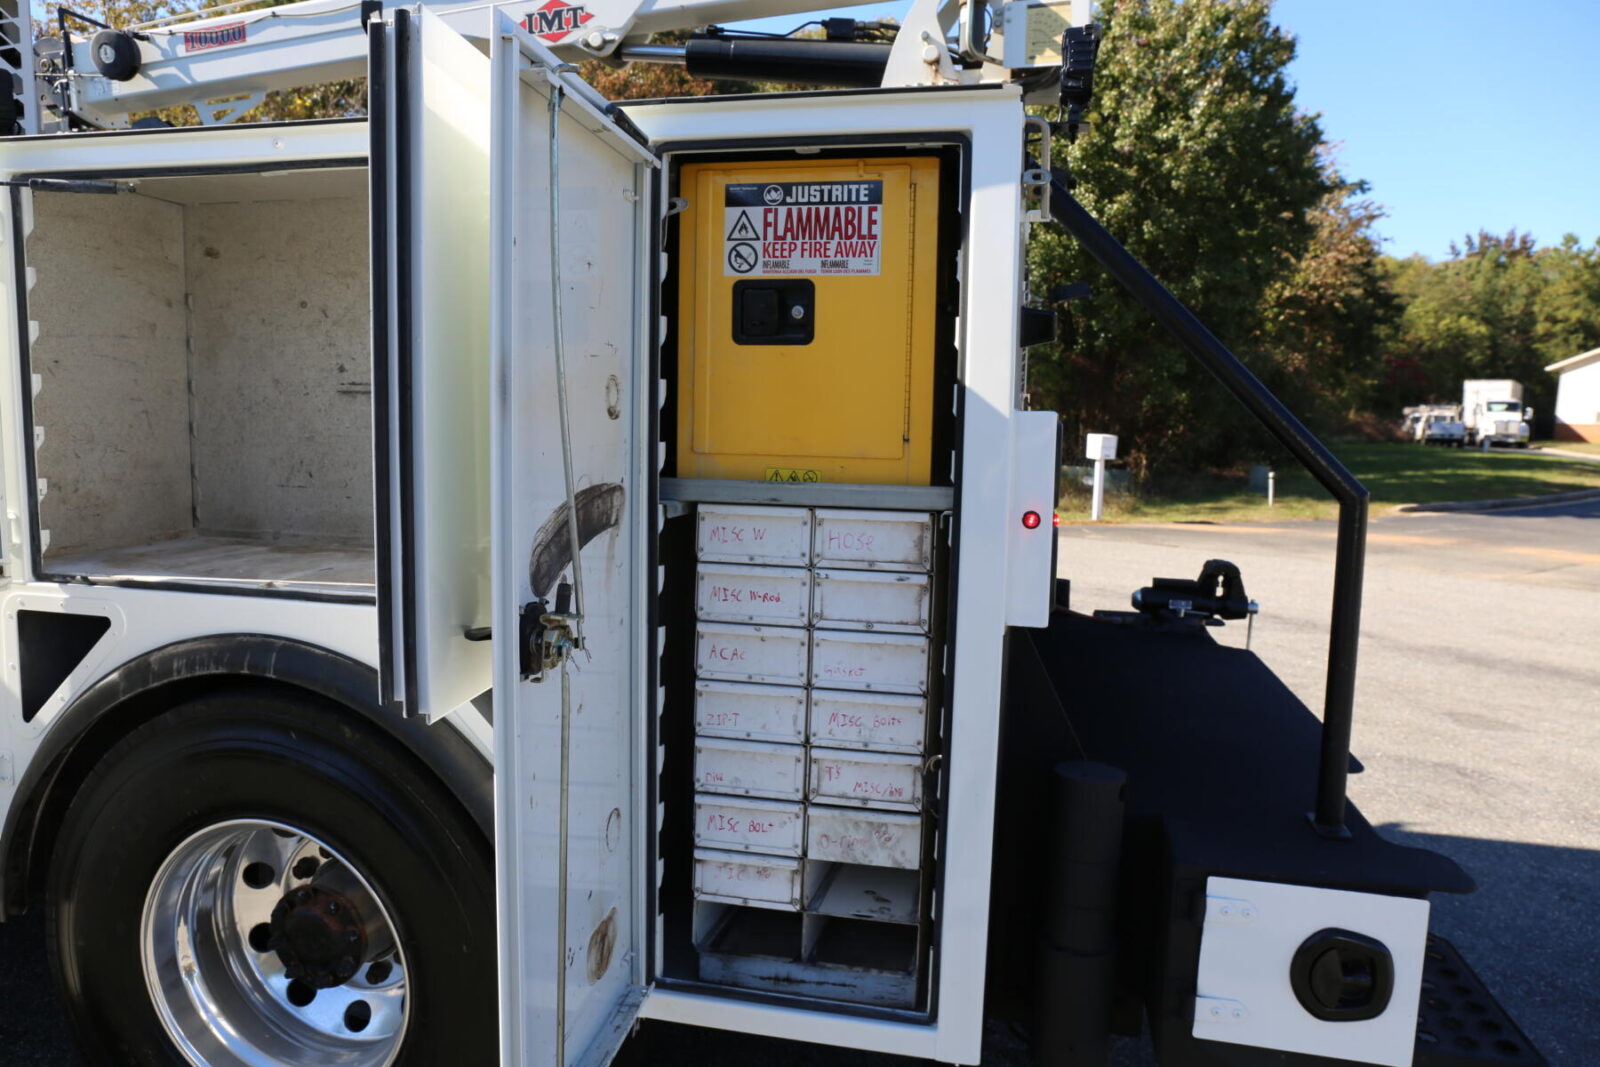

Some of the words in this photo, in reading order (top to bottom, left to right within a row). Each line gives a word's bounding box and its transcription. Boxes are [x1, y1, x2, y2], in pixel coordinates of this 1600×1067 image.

[526, 6, 584, 35] IMT
[786, 184, 869, 203] JUSTRITE
[762, 206, 878, 241] FLAMMABLE
[762, 242, 797, 259] KEEP
[801, 241, 829, 258] FIRE
[834, 241, 877, 258] AWAY
